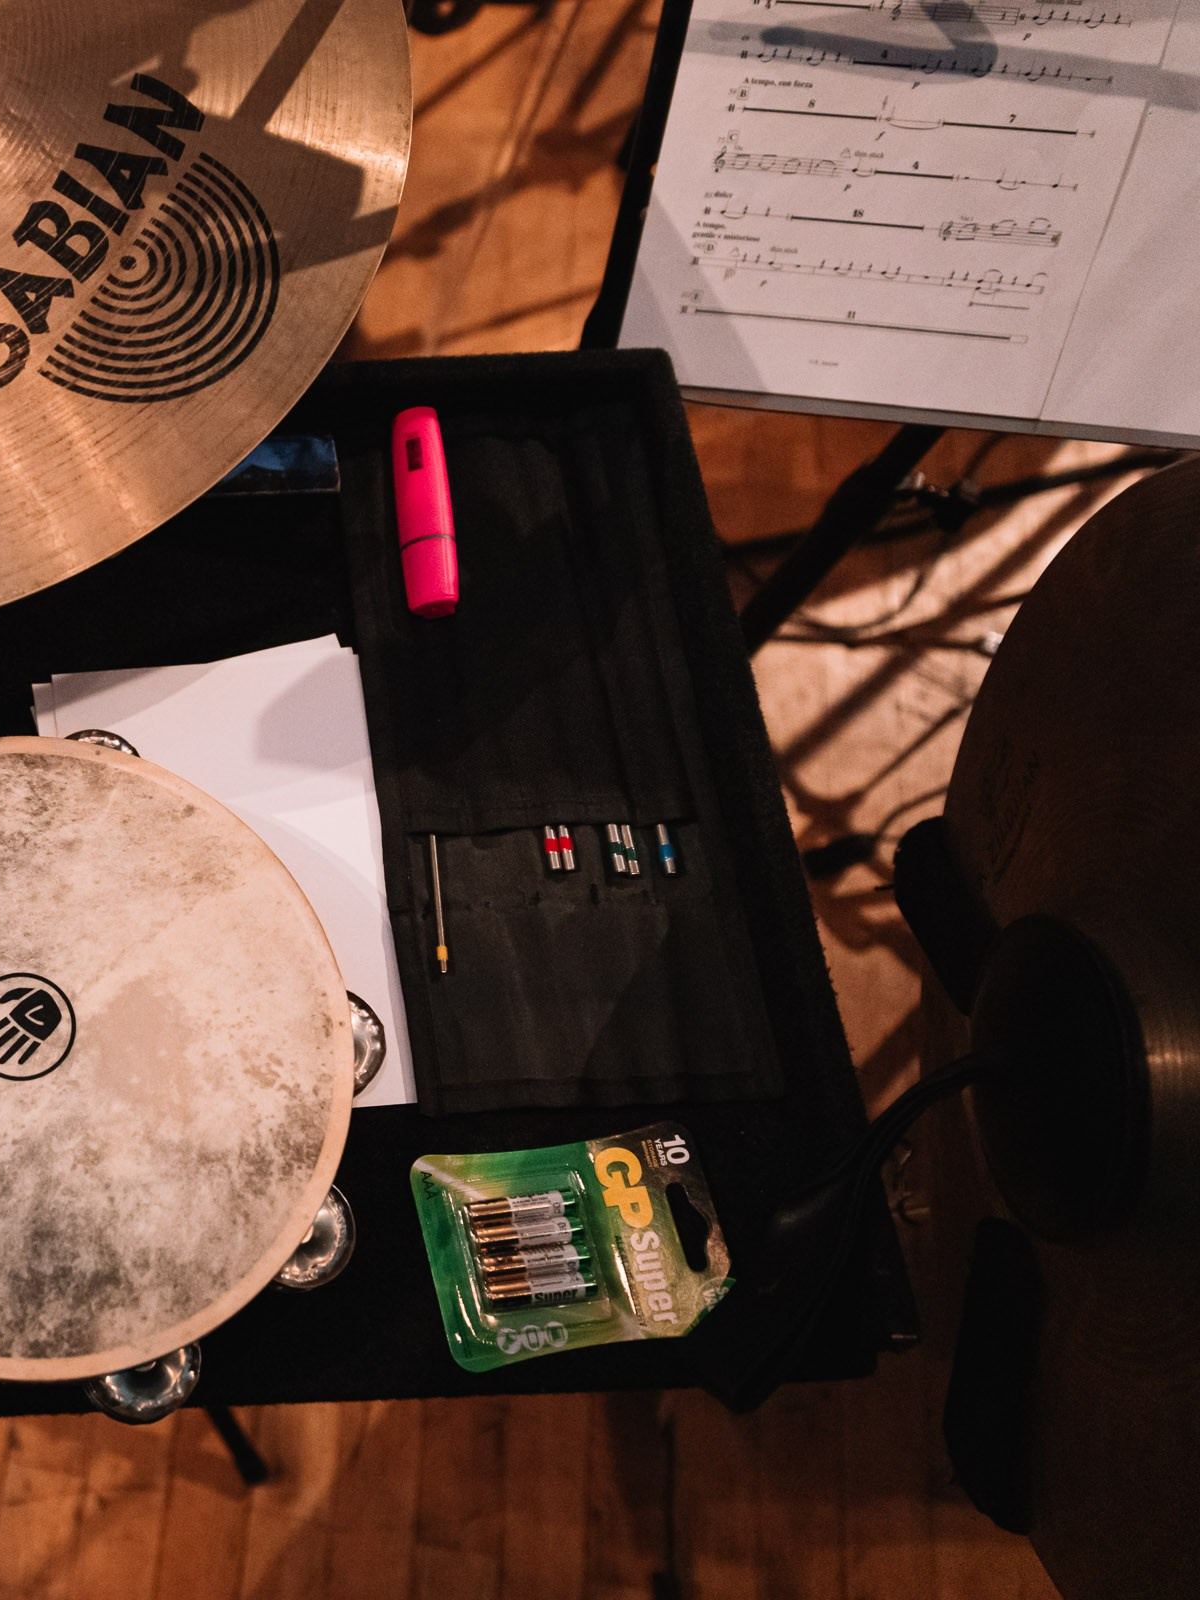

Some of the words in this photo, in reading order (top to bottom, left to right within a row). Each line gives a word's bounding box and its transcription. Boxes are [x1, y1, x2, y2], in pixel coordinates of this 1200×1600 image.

[853, 209, 864, 217] 18
[654, 1138, 668, 1167] YEARS
[664, 1133, 690, 1166] 10
[420, 1170, 439, 1200] AAA
[594, 1147, 654, 1229] GP
[630, 1230, 679, 1325] Super
